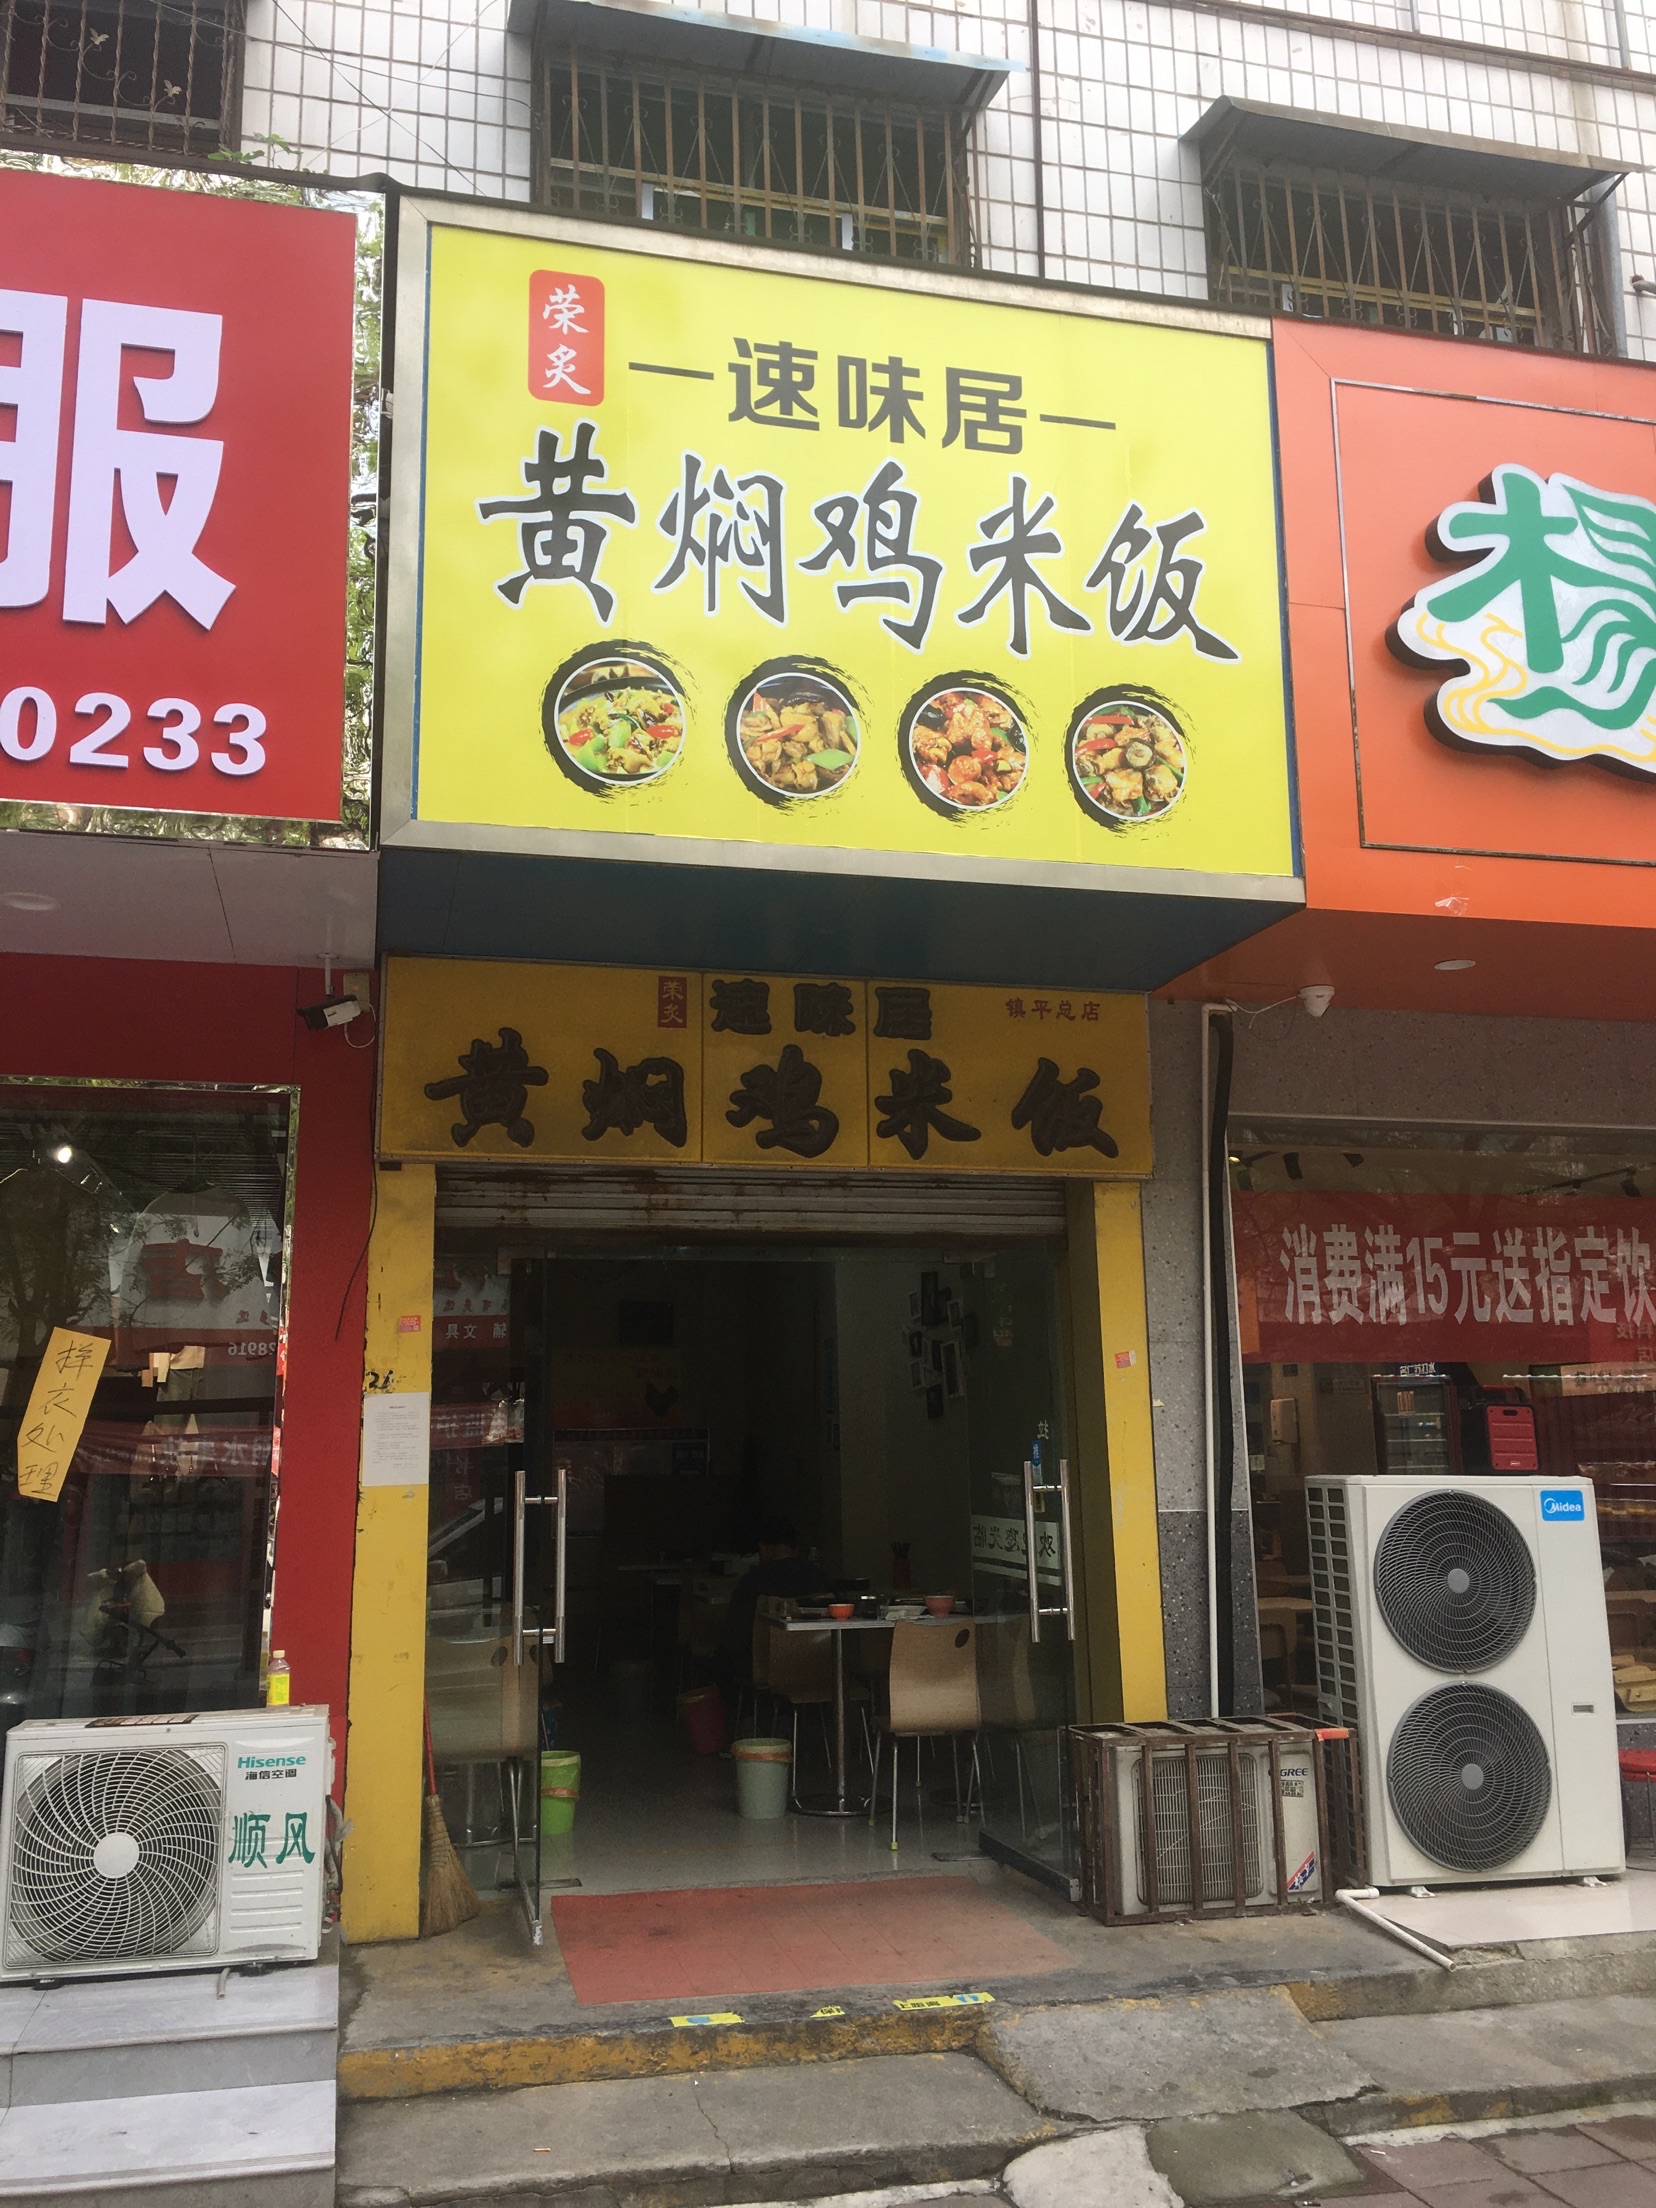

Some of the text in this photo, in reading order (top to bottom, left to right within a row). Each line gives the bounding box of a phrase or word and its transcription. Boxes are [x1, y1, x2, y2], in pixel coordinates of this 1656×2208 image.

[728, 337, 1025, 455] 速味居
[0, 288, 236, 631] 服
[479, 420, 1240, 663] 黄焖鸡米饭
[708, 979, 932, 1041] 速味居
[1004, 996, 1102, 1023] 镇平总店
[423, 1026, 1120, 1160] 黄焖鸡米饭
[1279, 1223, 1656, 1327] 消费满15元送指定饮
[1543, 1496, 1582, 1514] Midea
[236, 1755, 307, 1770] Hisense
[244, 1769, 298, 1781] 海信空调
[1279, 1766, 1310, 1778] GREE
[227, 1811, 316, 1869] 顺风
